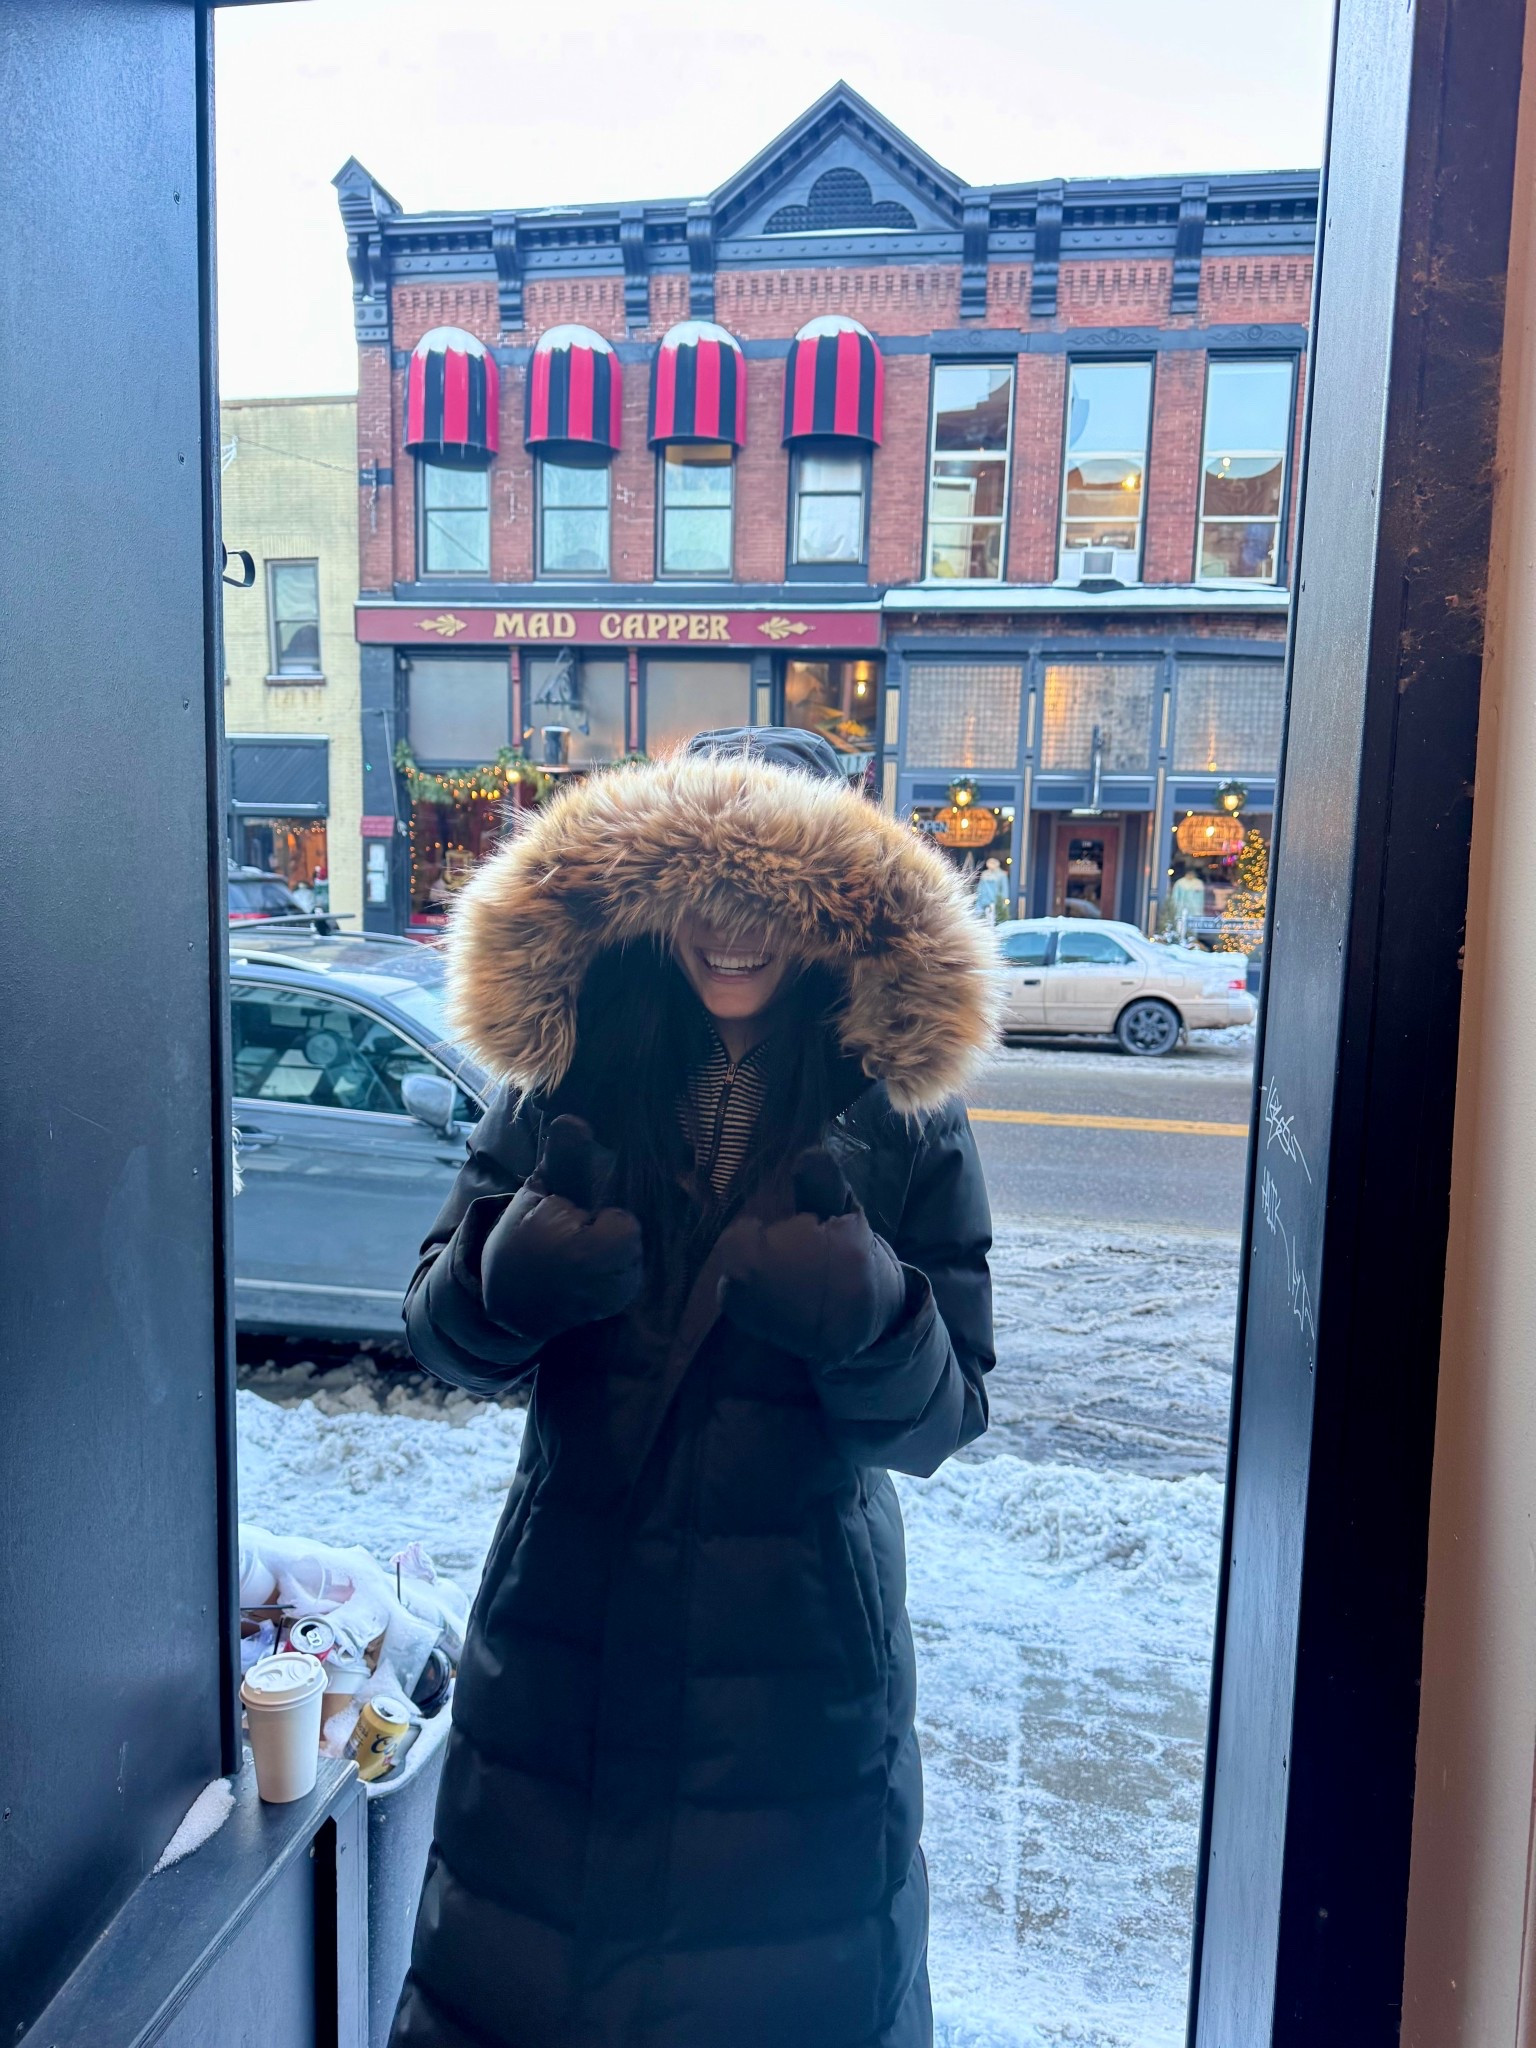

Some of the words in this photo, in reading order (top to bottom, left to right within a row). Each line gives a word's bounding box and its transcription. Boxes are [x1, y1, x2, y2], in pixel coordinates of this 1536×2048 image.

[493, 612, 577, 639] MAD
[599, 613, 732, 640] CAPPER
[916, 819, 949, 833] OPEN
